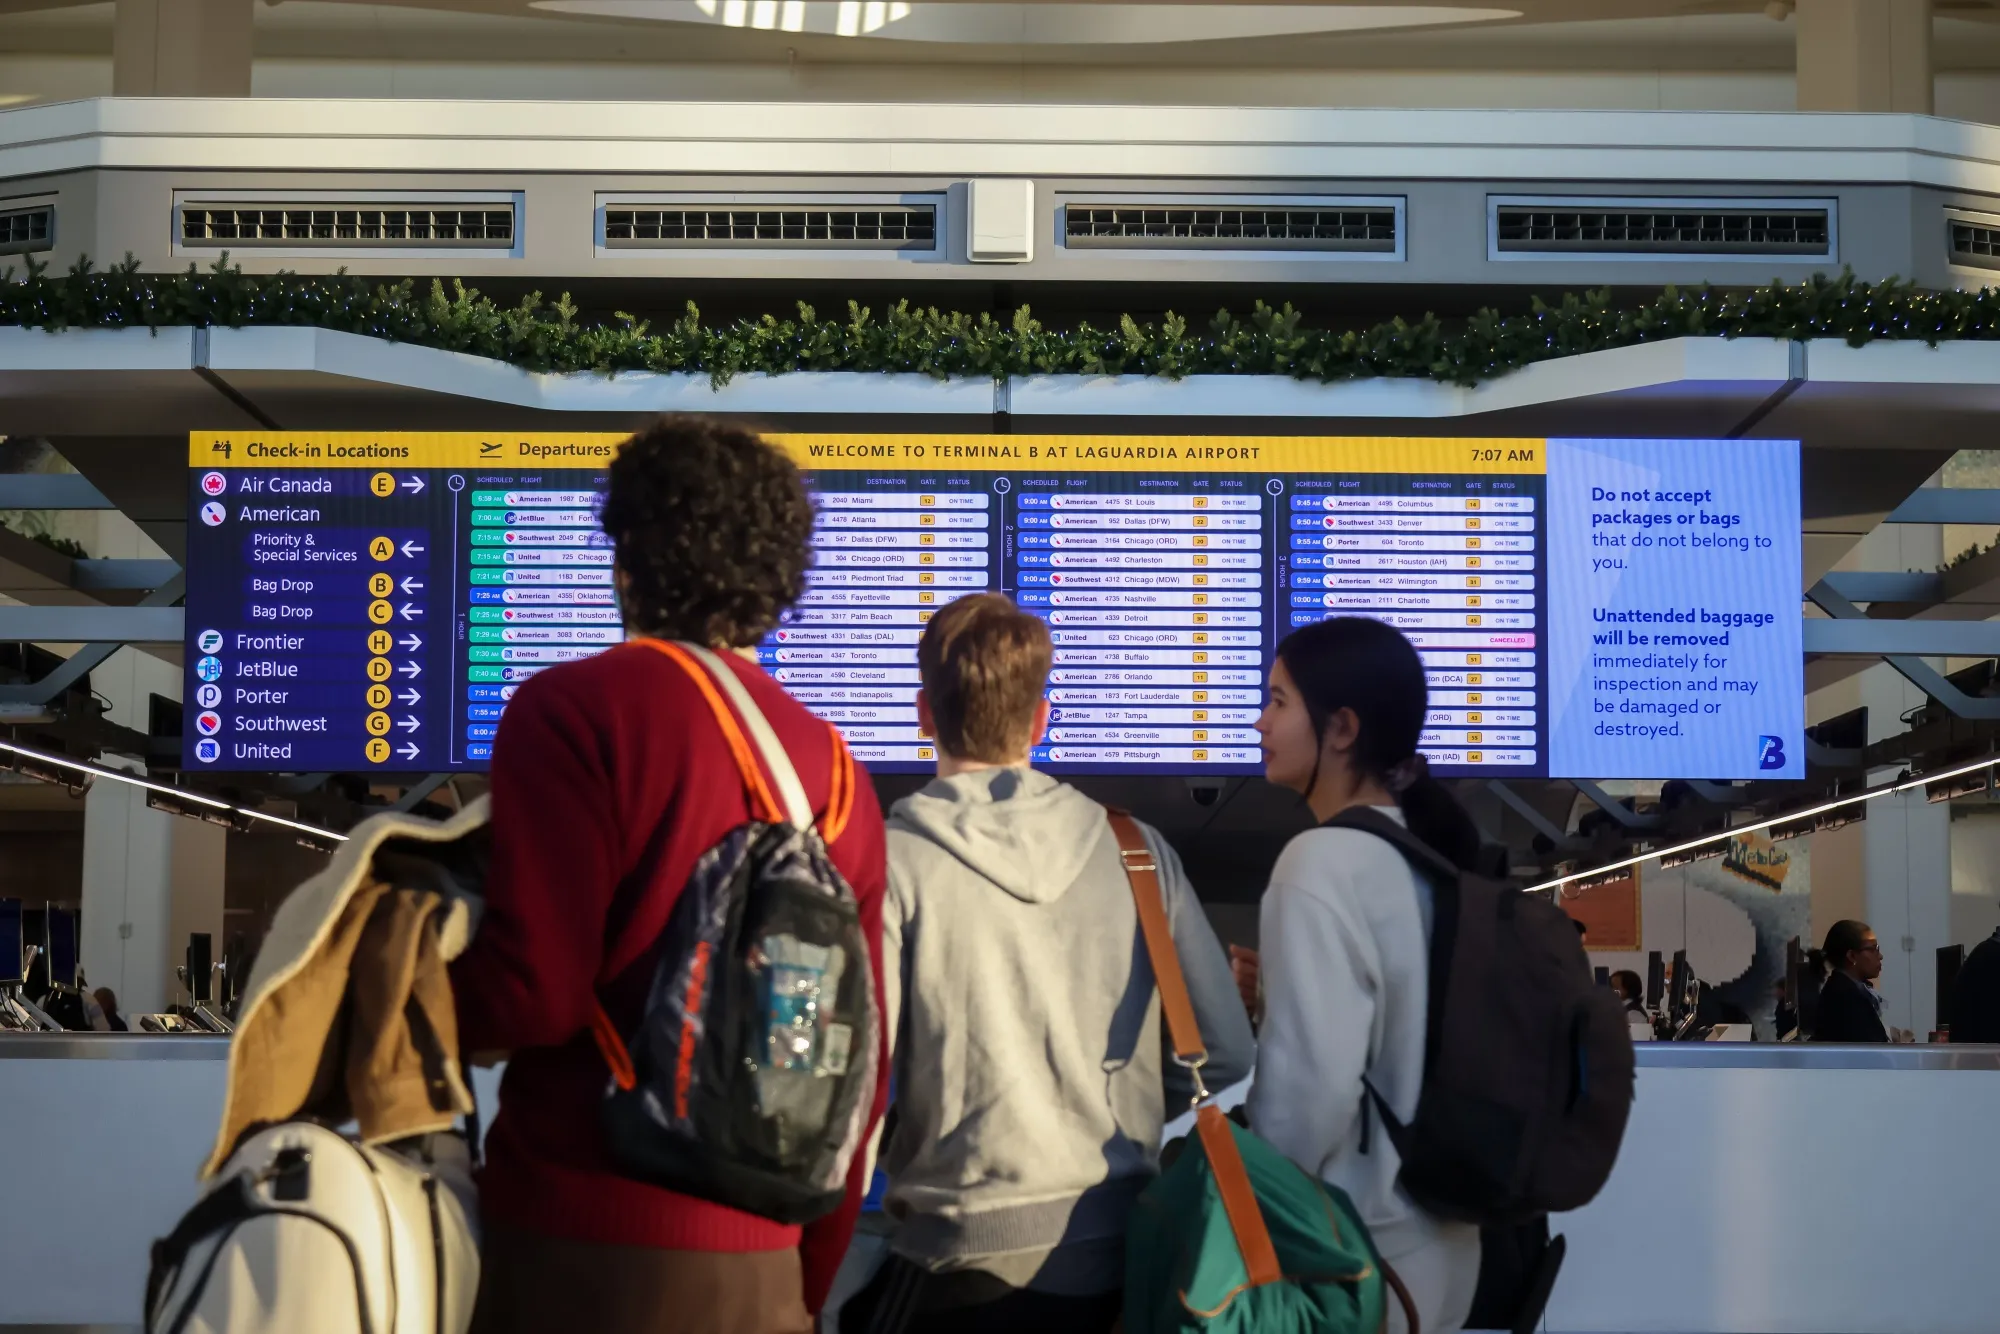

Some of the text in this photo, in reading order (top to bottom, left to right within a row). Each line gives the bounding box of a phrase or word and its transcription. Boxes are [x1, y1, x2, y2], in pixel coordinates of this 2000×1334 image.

[247, 443, 408, 458] Check-in Locations
[519, 443, 610, 458] Departures
[810, 445, 1260, 459] WELCOME TO TERMINAL B AT LAGUARDIA AIRPORT
[1472, 449, 1534, 462] 7:07 AM
[240, 478, 332, 492] Air Canada
[378, 479, 386, 491] E
[1592, 488, 1711, 505] Do not accept
[240, 507, 320, 521] American
[1592, 510, 1740, 528] packages or bags
[254, 534, 315, 547] Priority &
[1592, 533, 1772, 551] that do not belong to
[376, 542, 387, 555] A
[254, 550, 357, 563] Special Services
[1592, 557, 1628, 572] you.
[253, 579, 313, 593] Bag Drop
[376, 579, 386, 592] B
[253, 606, 313, 620] Bag Drop
[374, 604, 385, 618] C
[1593, 608, 1774, 627] Unattended baggage
[237, 634, 304, 649] Frontier
[374, 636, 386, 649] H
[1593, 631, 1729, 646] will be removed
[236, 662, 297, 677] JetBlue
[374, 663, 386, 676] D
[1594, 653, 1727, 672] immediately for
[1594, 677, 1758, 695] inspection and may
[237, 689, 288, 703] Porter
[374, 690, 385, 703] D
[1594, 698, 1721, 717] be damaged or
[235, 716, 327, 730] Southwest
[372, 716, 383, 730] G
[1594, 721, 1683, 739] destroyed.
[235, 743, 291, 758] United
[374, 744, 382, 757] F
